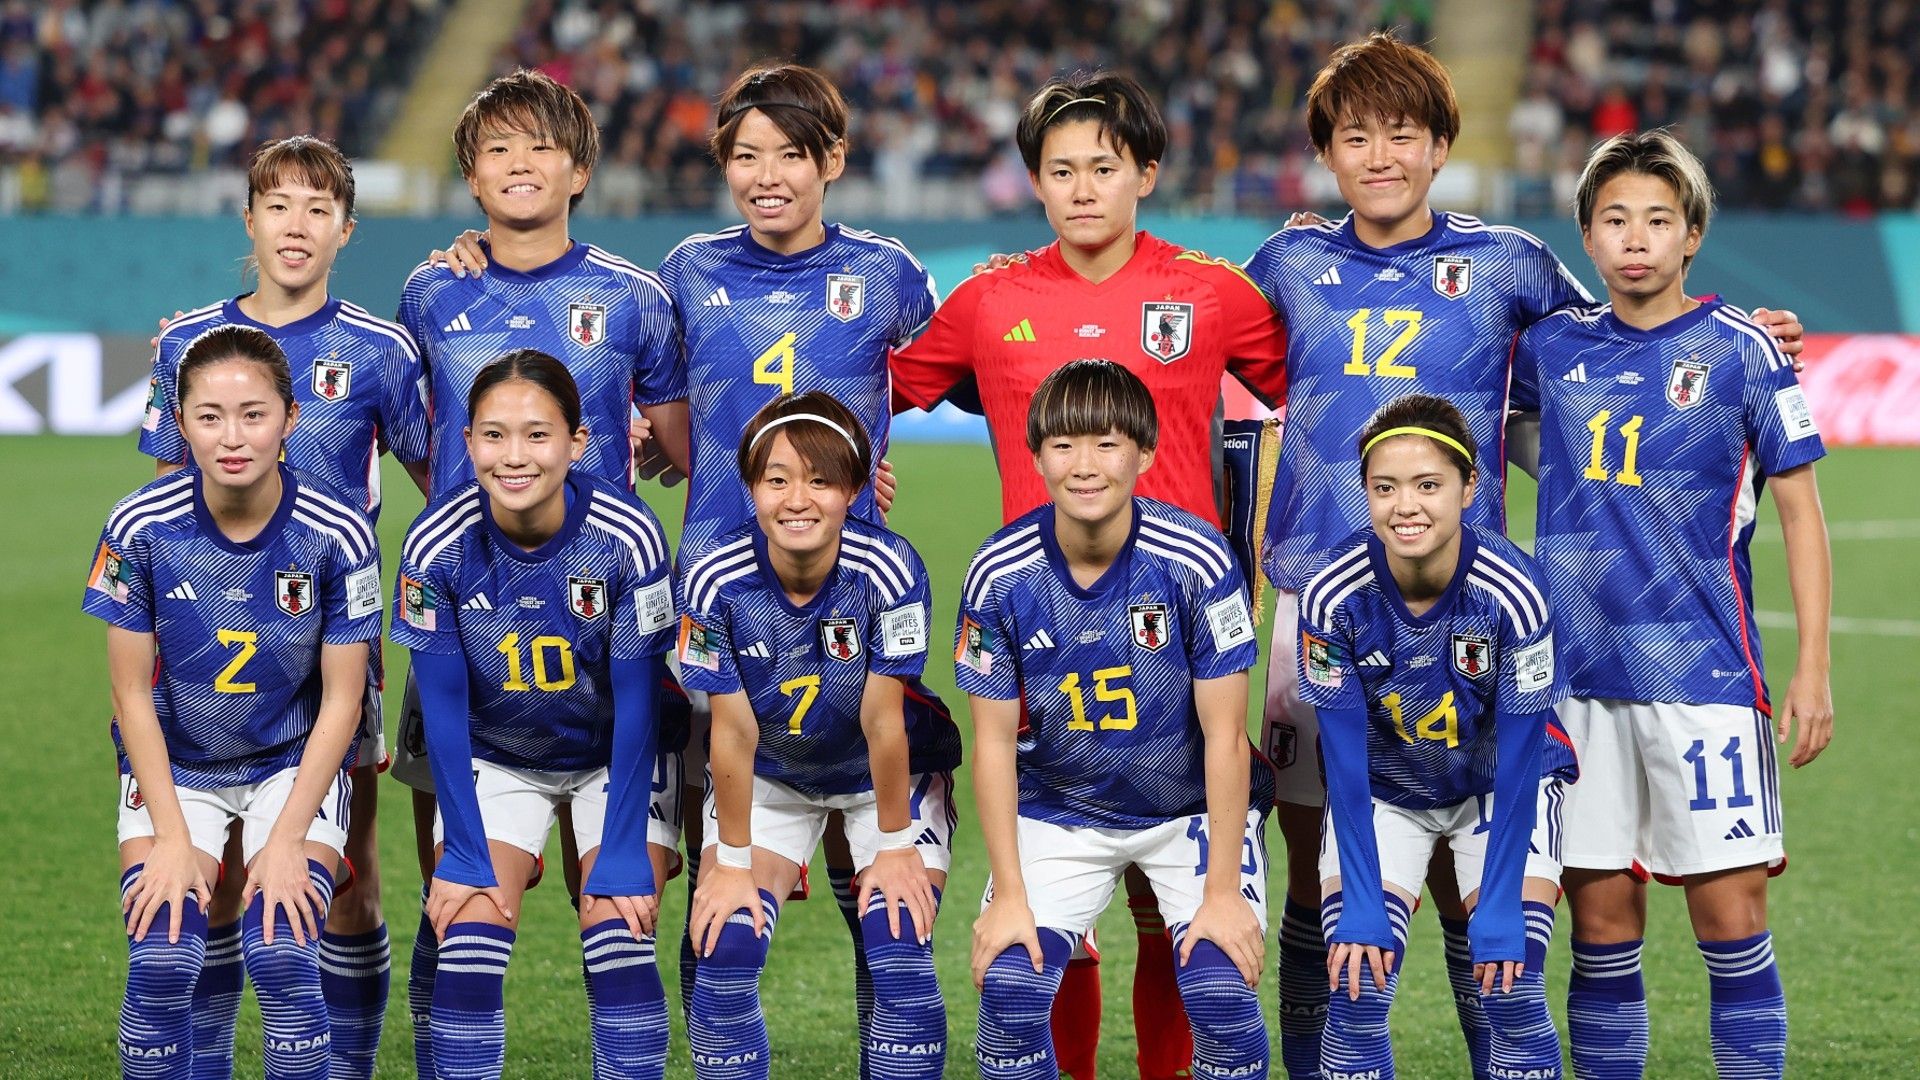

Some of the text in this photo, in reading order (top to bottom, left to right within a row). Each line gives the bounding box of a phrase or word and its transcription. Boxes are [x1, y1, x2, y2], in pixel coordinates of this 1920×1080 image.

[1155, 303, 1180, 311] JAPAN
[1155, 342, 1175, 354] JFA
[1343, 308, 1423, 379] 12
[323, 361, 343, 369] JAPAN
[753, 332, 796, 395] 4
[1584, 409, 1644, 487] 11
[357, 581, 378, 593] UNITES
[646, 596, 668, 609] UNITES
[892, 612, 917, 624] FOOTBALL
[892, 619, 919, 631] UNITES
[1219, 609, 1243, 626] UNITES
[900, 637, 914, 645] FIFA
[215, 628, 257, 693] 2
[496, 631, 576, 692] 10
[779, 674, 821, 735] 7
[1057, 664, 1138, 731] 15
[1381, 690, 1459, 748] 14
[1682, 736, 1754, 811] 11
[120, 1042, 177, 1058] APAN
[269, 1031, 331, 1053] JAPAN
[868, 1040, 942, 1055] JAPAN
[977, 1050, 1047, 1068] JAPAN
[1192, 1059, 1262, 1077] JAPAN
[1488, 1066, 1556, 1080] JAPAN
